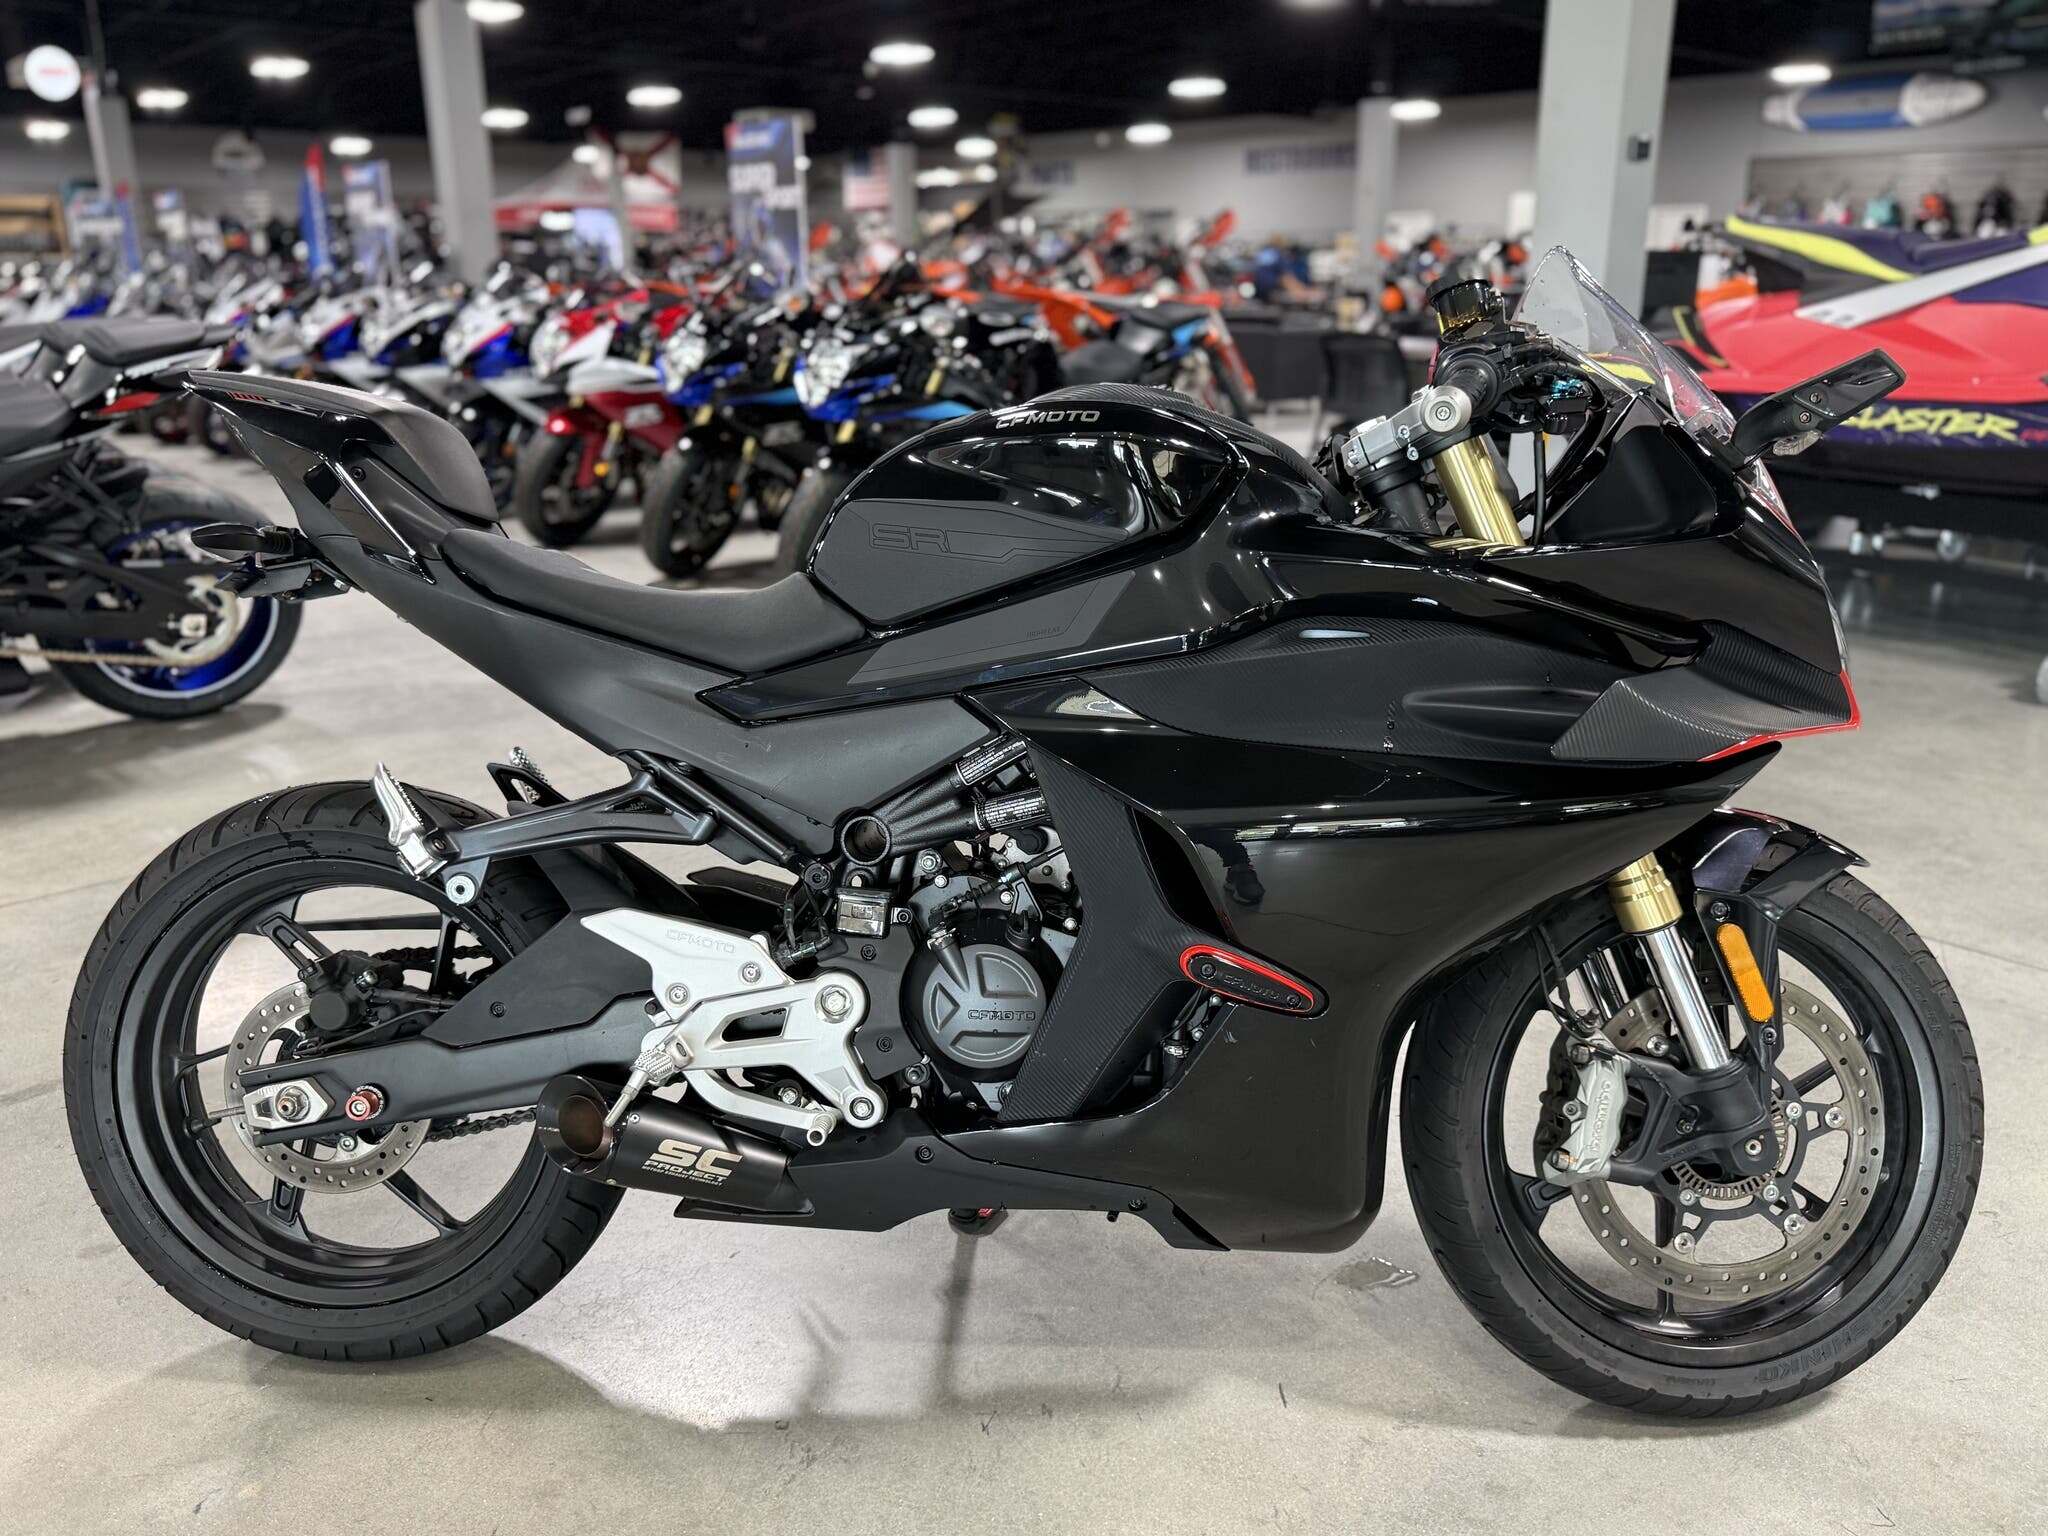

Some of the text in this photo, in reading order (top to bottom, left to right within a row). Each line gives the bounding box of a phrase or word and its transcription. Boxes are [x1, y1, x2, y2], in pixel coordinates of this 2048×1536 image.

[995, 410, 1101, 430] CFMOTO
[872, 523, 949, 553] SR
[666, 929, 736, 954] CFMOTO
[967, 1009, 1036, 1021] CFMOTO
[1587, 1080, 1612, 1152] brembo
[649, 1139, 743, 1176] SC
[643, 1159, 727, 1182] PROJECT
